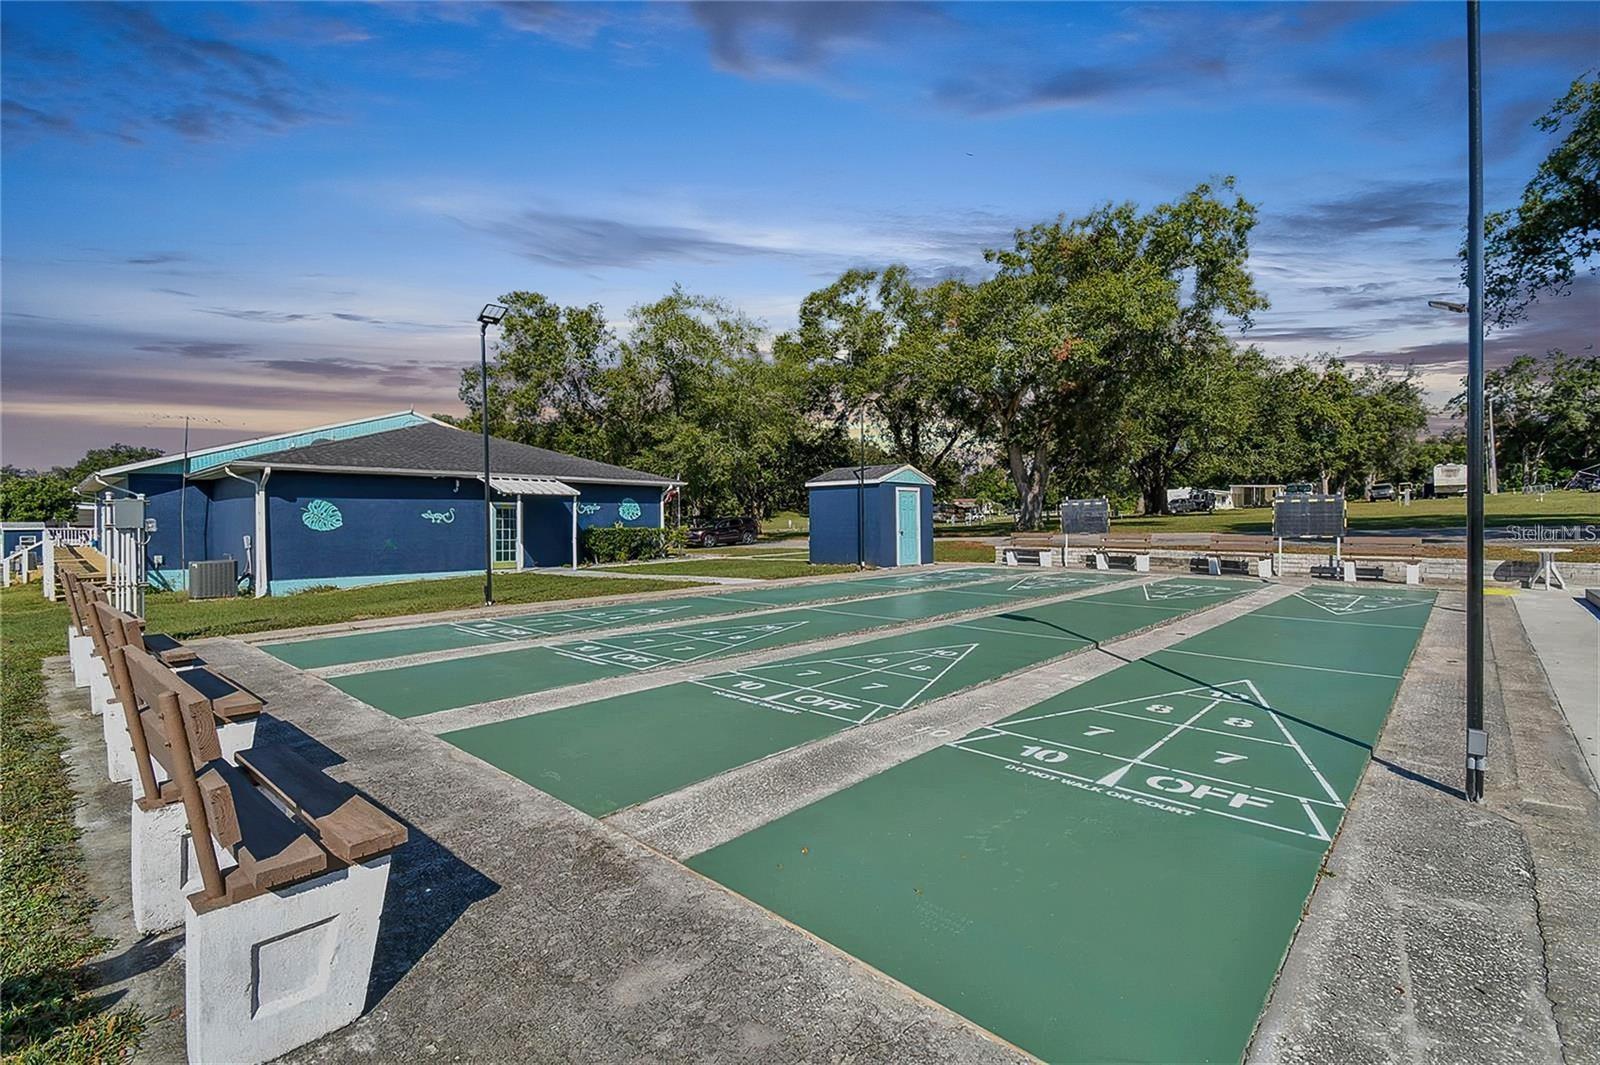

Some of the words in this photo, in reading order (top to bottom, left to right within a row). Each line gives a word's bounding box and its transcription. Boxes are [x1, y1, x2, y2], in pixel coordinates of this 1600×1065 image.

[732, 680, 766, 690] 10
[862, 682, 889, 690] 7
[794, 694, 863, 711] OFF
[1083, 725, 1115, 736] 7
[1020, 744, 1069, 763] 10
[1214, 750, 1249, 764] 7
[1004, 764, 1027, 773] DO
[1027, 770, 1061, 781] NOT
[1060, 778, 1104, 793] WALK
[1105, 790, 1133, 800] ON
[1132, 797, 1196, 816] COURT
[1146, 775, 1275, 808] OFF
